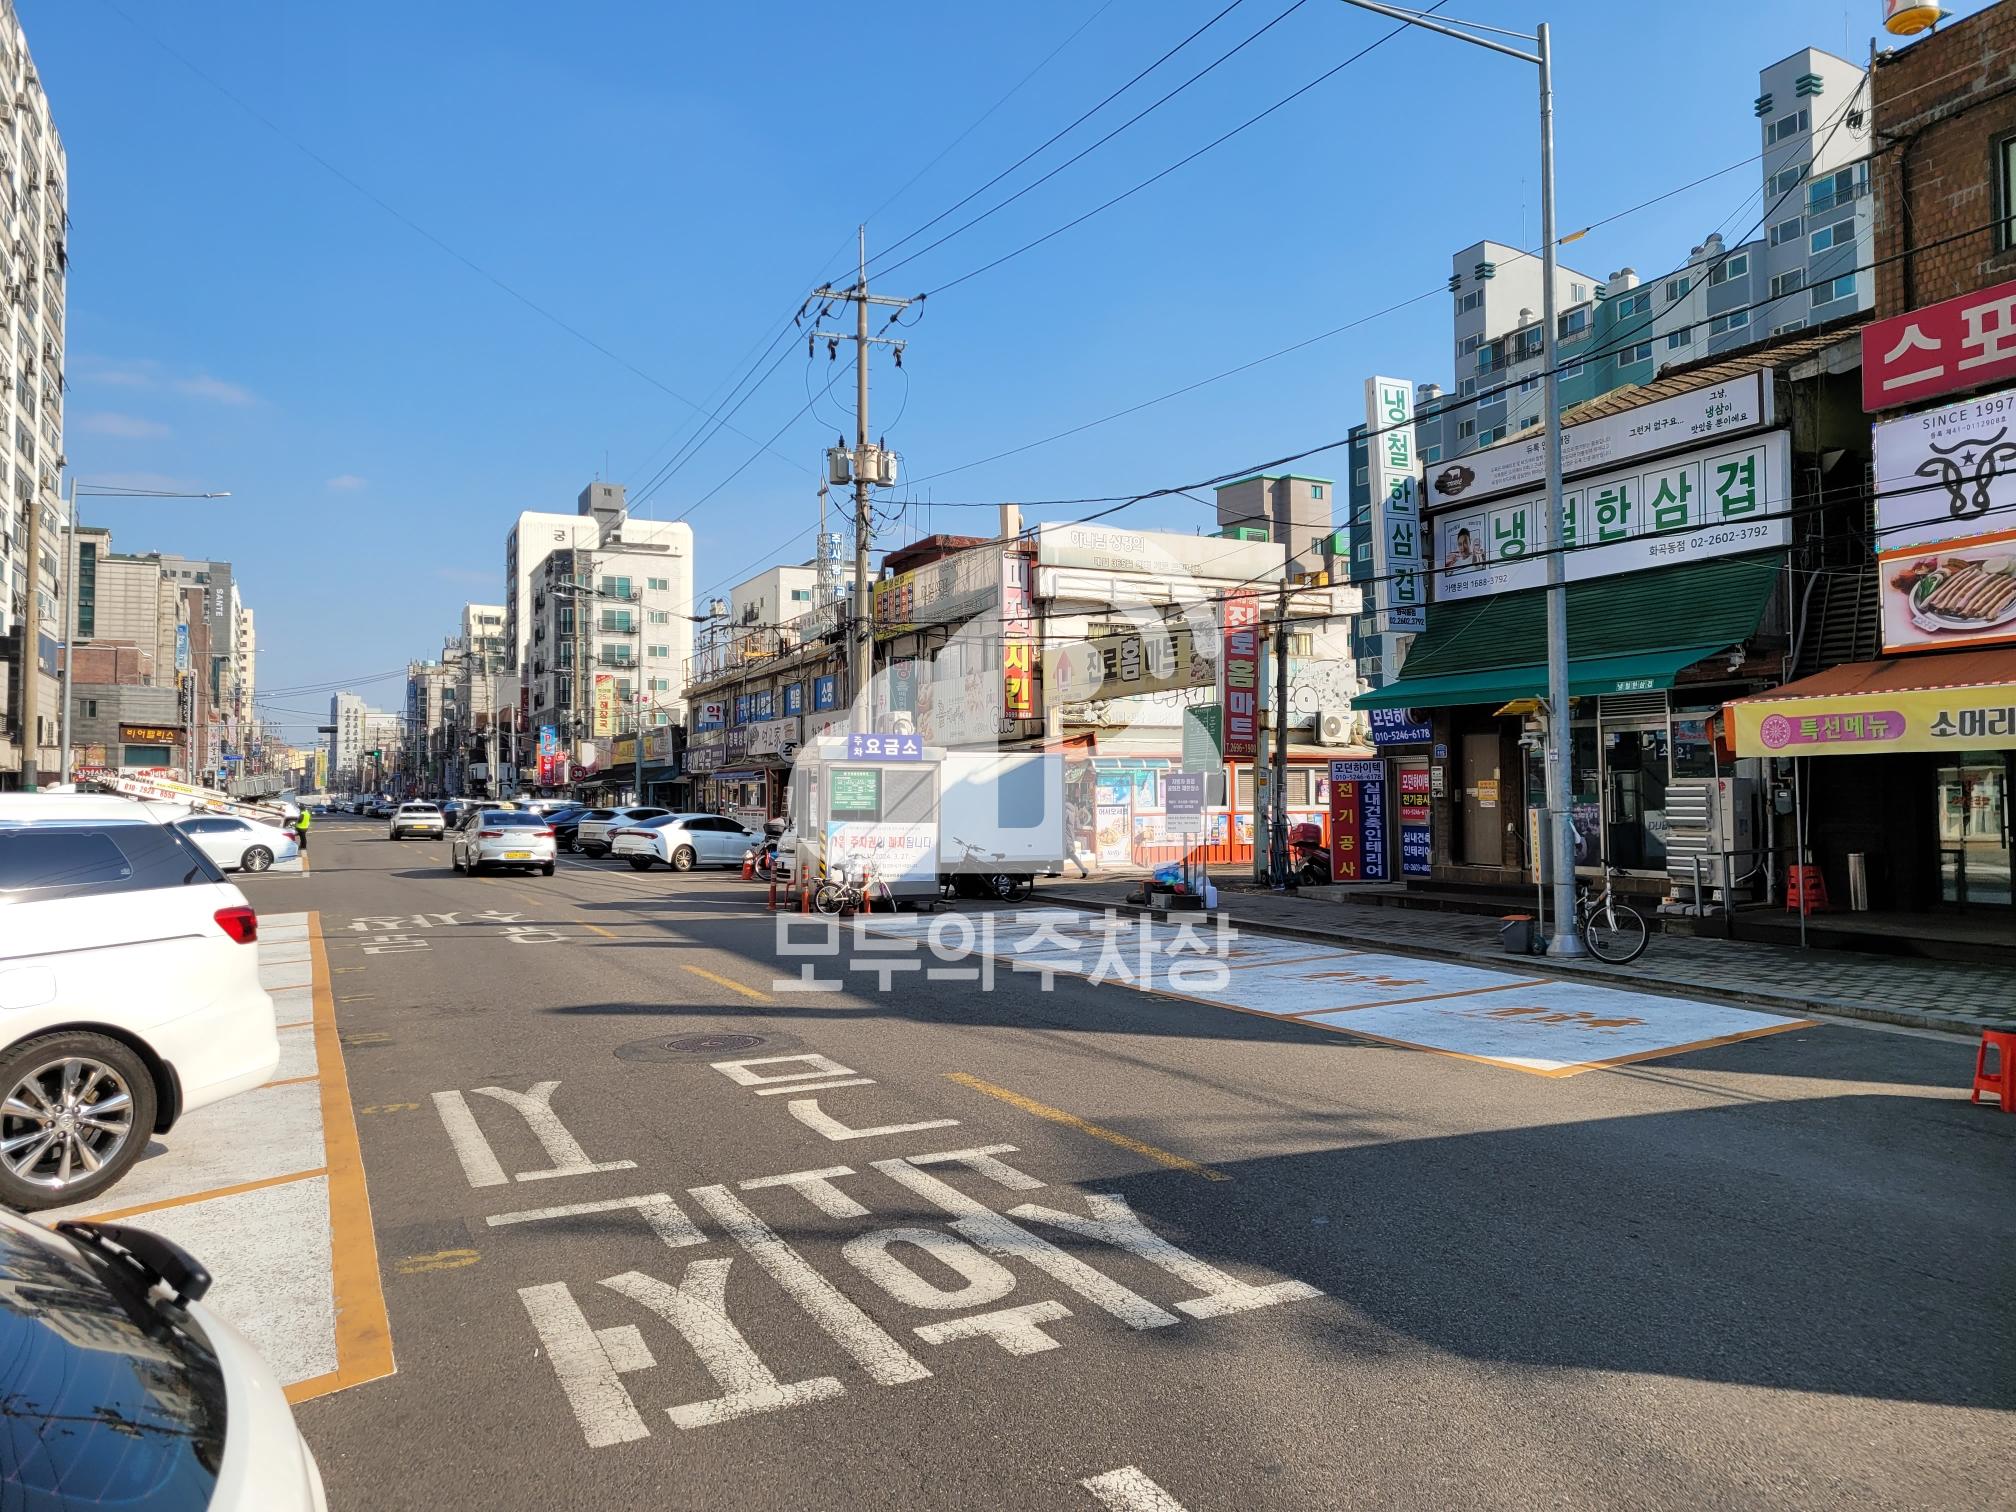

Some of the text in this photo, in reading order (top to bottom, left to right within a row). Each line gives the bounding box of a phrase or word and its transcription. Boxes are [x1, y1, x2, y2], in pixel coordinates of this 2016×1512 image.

[1705, 403, 1732, 418] 냉삼이
[1923, 397, 2015, 430] SINCE 1997
[1071, 530, 1107, 549] 하나님
[1649, 525, 1769, 557] 화곡동점 02-2602-3792
[1471, 574, 1508, 588] 1688-3792
[215, 588, 224, 617] SANTE
[1228, 606, 1256, 741] 진로홈마트
[1375, 728, 1431, 742] 010-5246-6178
[1800, 714, 1889, 741] 특선메뉴
[865, 738, 918, 756] 요금소
[1334, 761, 1382, 774] 모던하이텍
[1335, 773, 1382, 781] 010-5246-6178
[1402, 793, 1431, 806] 전기공사
[1337, 782, 1356, 877] 전기공사
[1363, 781, 1384, 877] 실내건축인테리어
